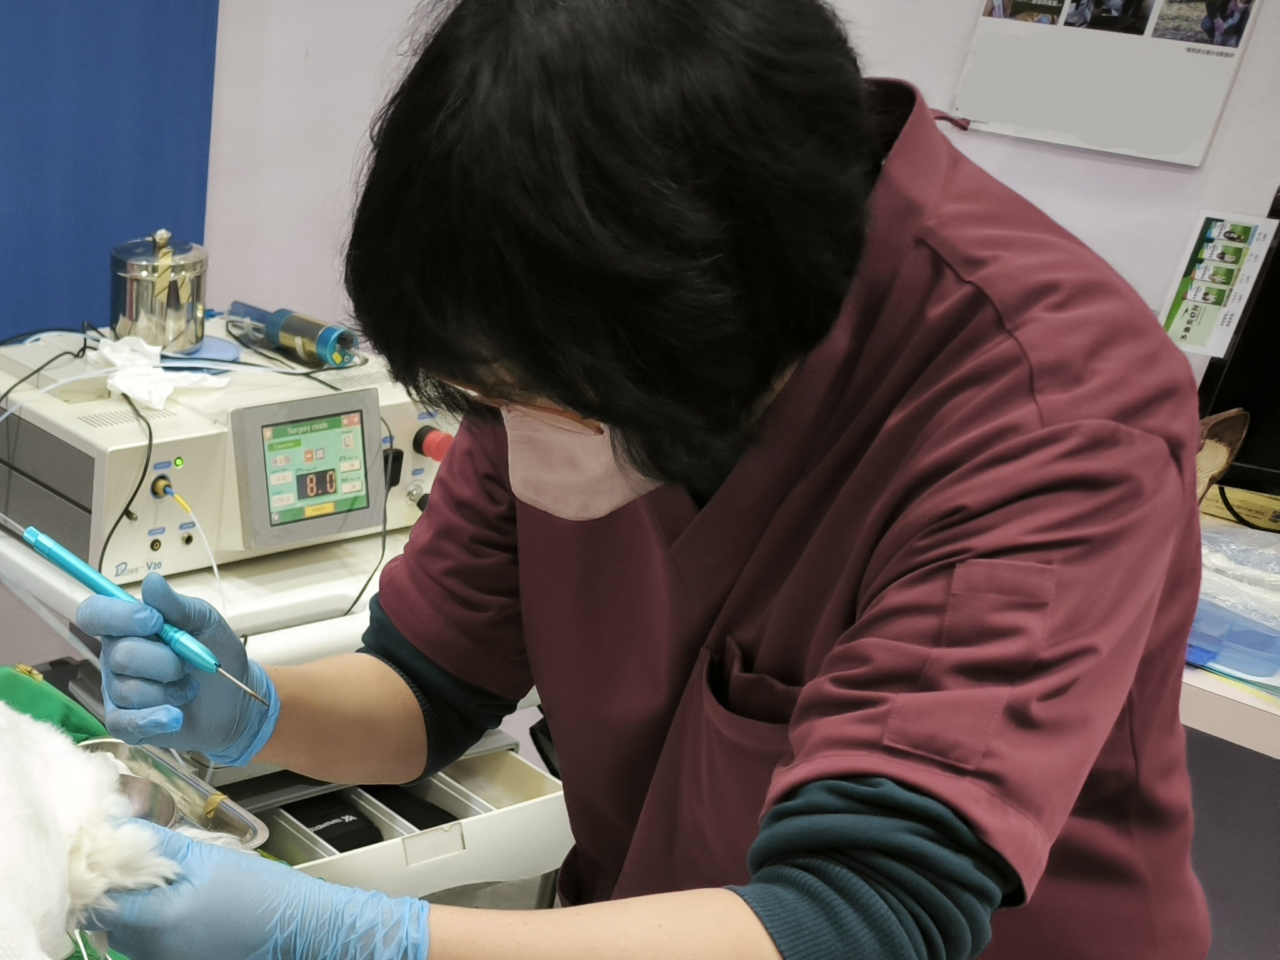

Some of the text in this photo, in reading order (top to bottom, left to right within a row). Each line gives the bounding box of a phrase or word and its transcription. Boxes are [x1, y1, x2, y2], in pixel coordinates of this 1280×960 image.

[287, 422, 329, 436] Surgery mode
[306, 470, 336, 497] 8.0
[146, 561, 162, 571] V20
